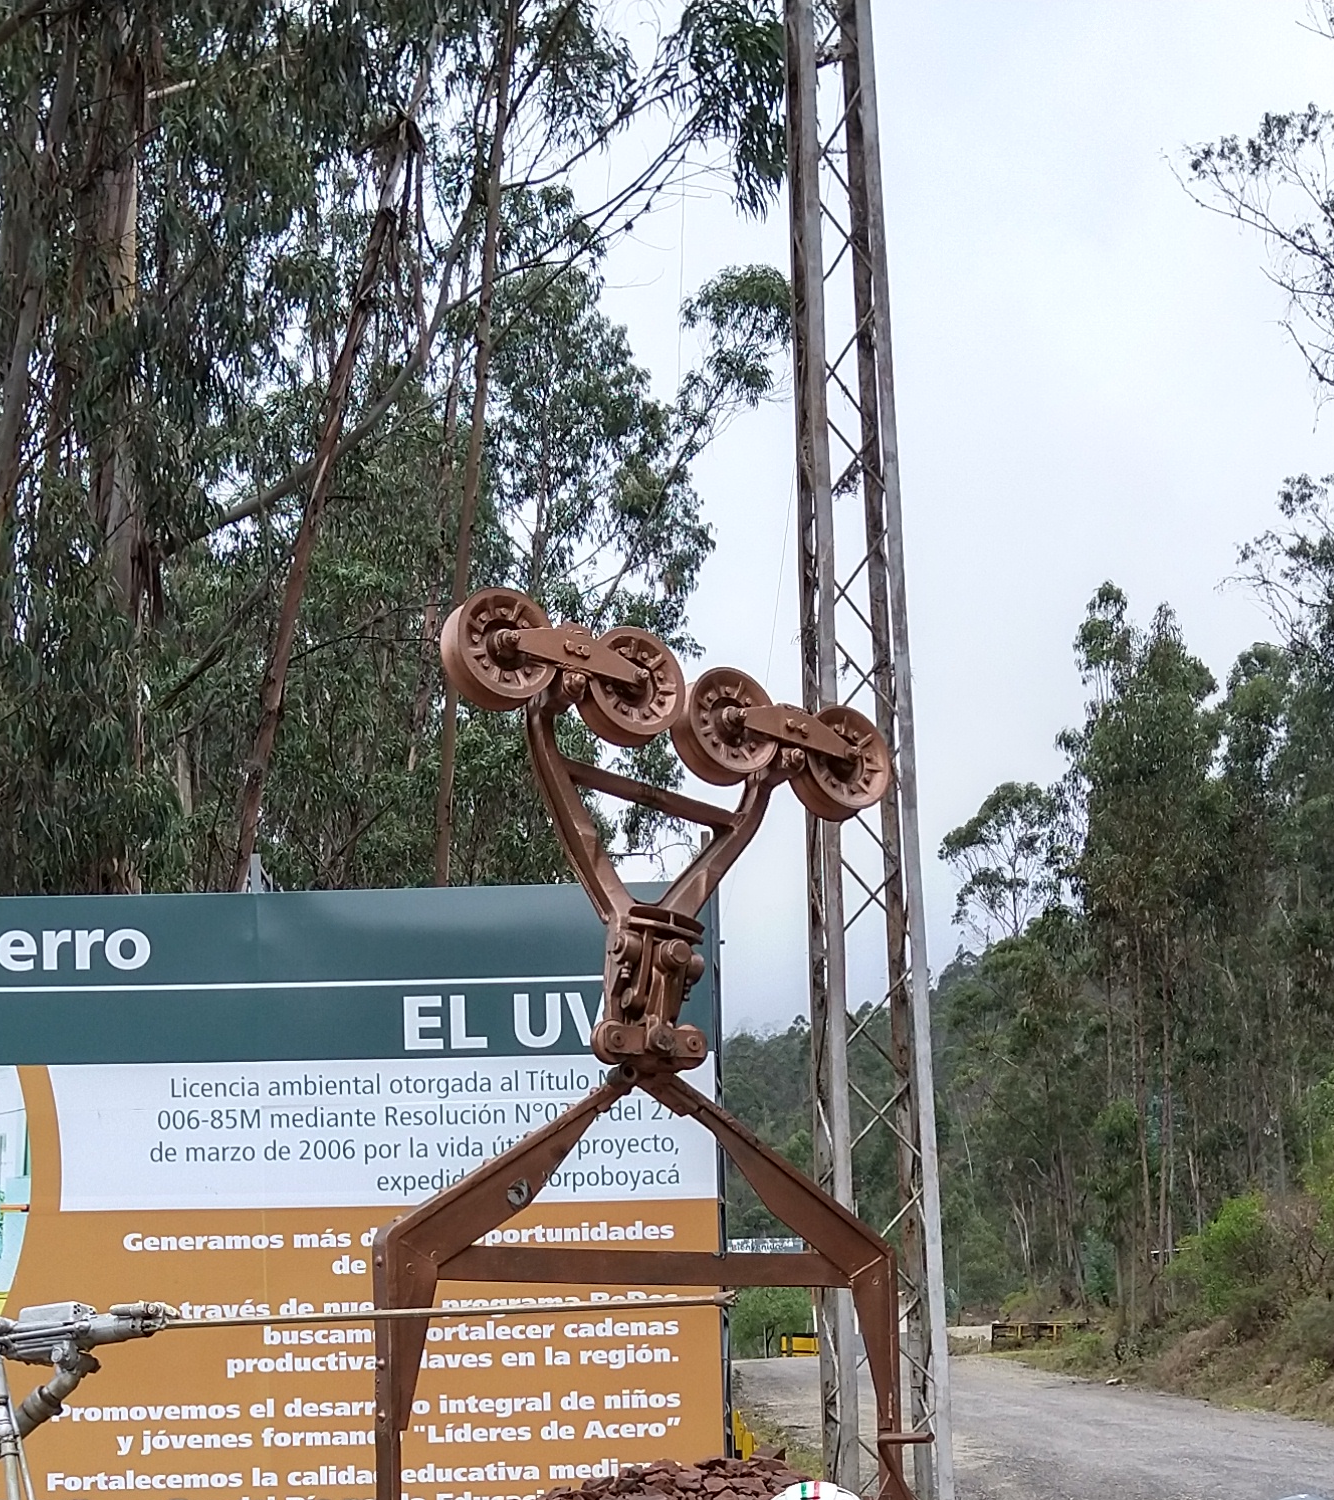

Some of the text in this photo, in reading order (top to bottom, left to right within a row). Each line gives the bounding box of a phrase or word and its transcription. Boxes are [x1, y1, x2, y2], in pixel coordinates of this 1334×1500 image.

[403, 991, 605, 1050] EL UV
[170, 1076, 260, 1098] Licencia
[268, 1073, 380, 1097] ambiental
[389, 1071, 492, 1099] otorgada
[500, 1070, 519, 1092] al
[525, 1068, 590, 1091] Título
[157, 1108, 261, 1131] 006-85M
[270, 1106, 376, 1129] mediante
[385, 1103, 510, 1126] Resolución
[609, 1099, 642, 1122] del
[150, 1141, 177, 1162] de
[185, 1145, 256, 1162] marzo
[263, 1139, 291, 1161] de
[298, 1139, 356, 1161] 2006
[364, 1143, 402, 1164] por
[409, 1137, 429, 1158] la
[436, 1136, 484, 1157] vida
[577, 1133, 680, 1160] proyecto,
[542, 1163, 680, 1193] orpoboyacá
[123, 1233, 284, 1252] Generamos
[293, 1229, 352, 1249] más
[332, 1255, 367, 1275] de
[178, 1299, 271, 1320] través
[279, 1298, 315, 1316] de
[263, 1317, 679, 1346] buscam ortalecer cadenas
[226, 1344, 680, 1379] productiva laves en la región.
[51, 1402, 240, 1422] Promovemos
[249, 1398, 275, 1418] el
[439, 1393, 551, 1418] integral
[560, 1391, 595, 1411] de
[604, 1389, 681, 1410] niños
[116, 1433, 134, 1456] y
[141, 1429, 253, 1455] jóvenes
[413, 1423, 532, 1444] "Líderes
[540, 1420, 575, 1440] de
[47, 1469, 244, 1491] Fortalecemos
[251, 1467, 278, 1488] la
[287, 1464, 377, 1486] calida
[400, 1462, 540, 1483] educativa
